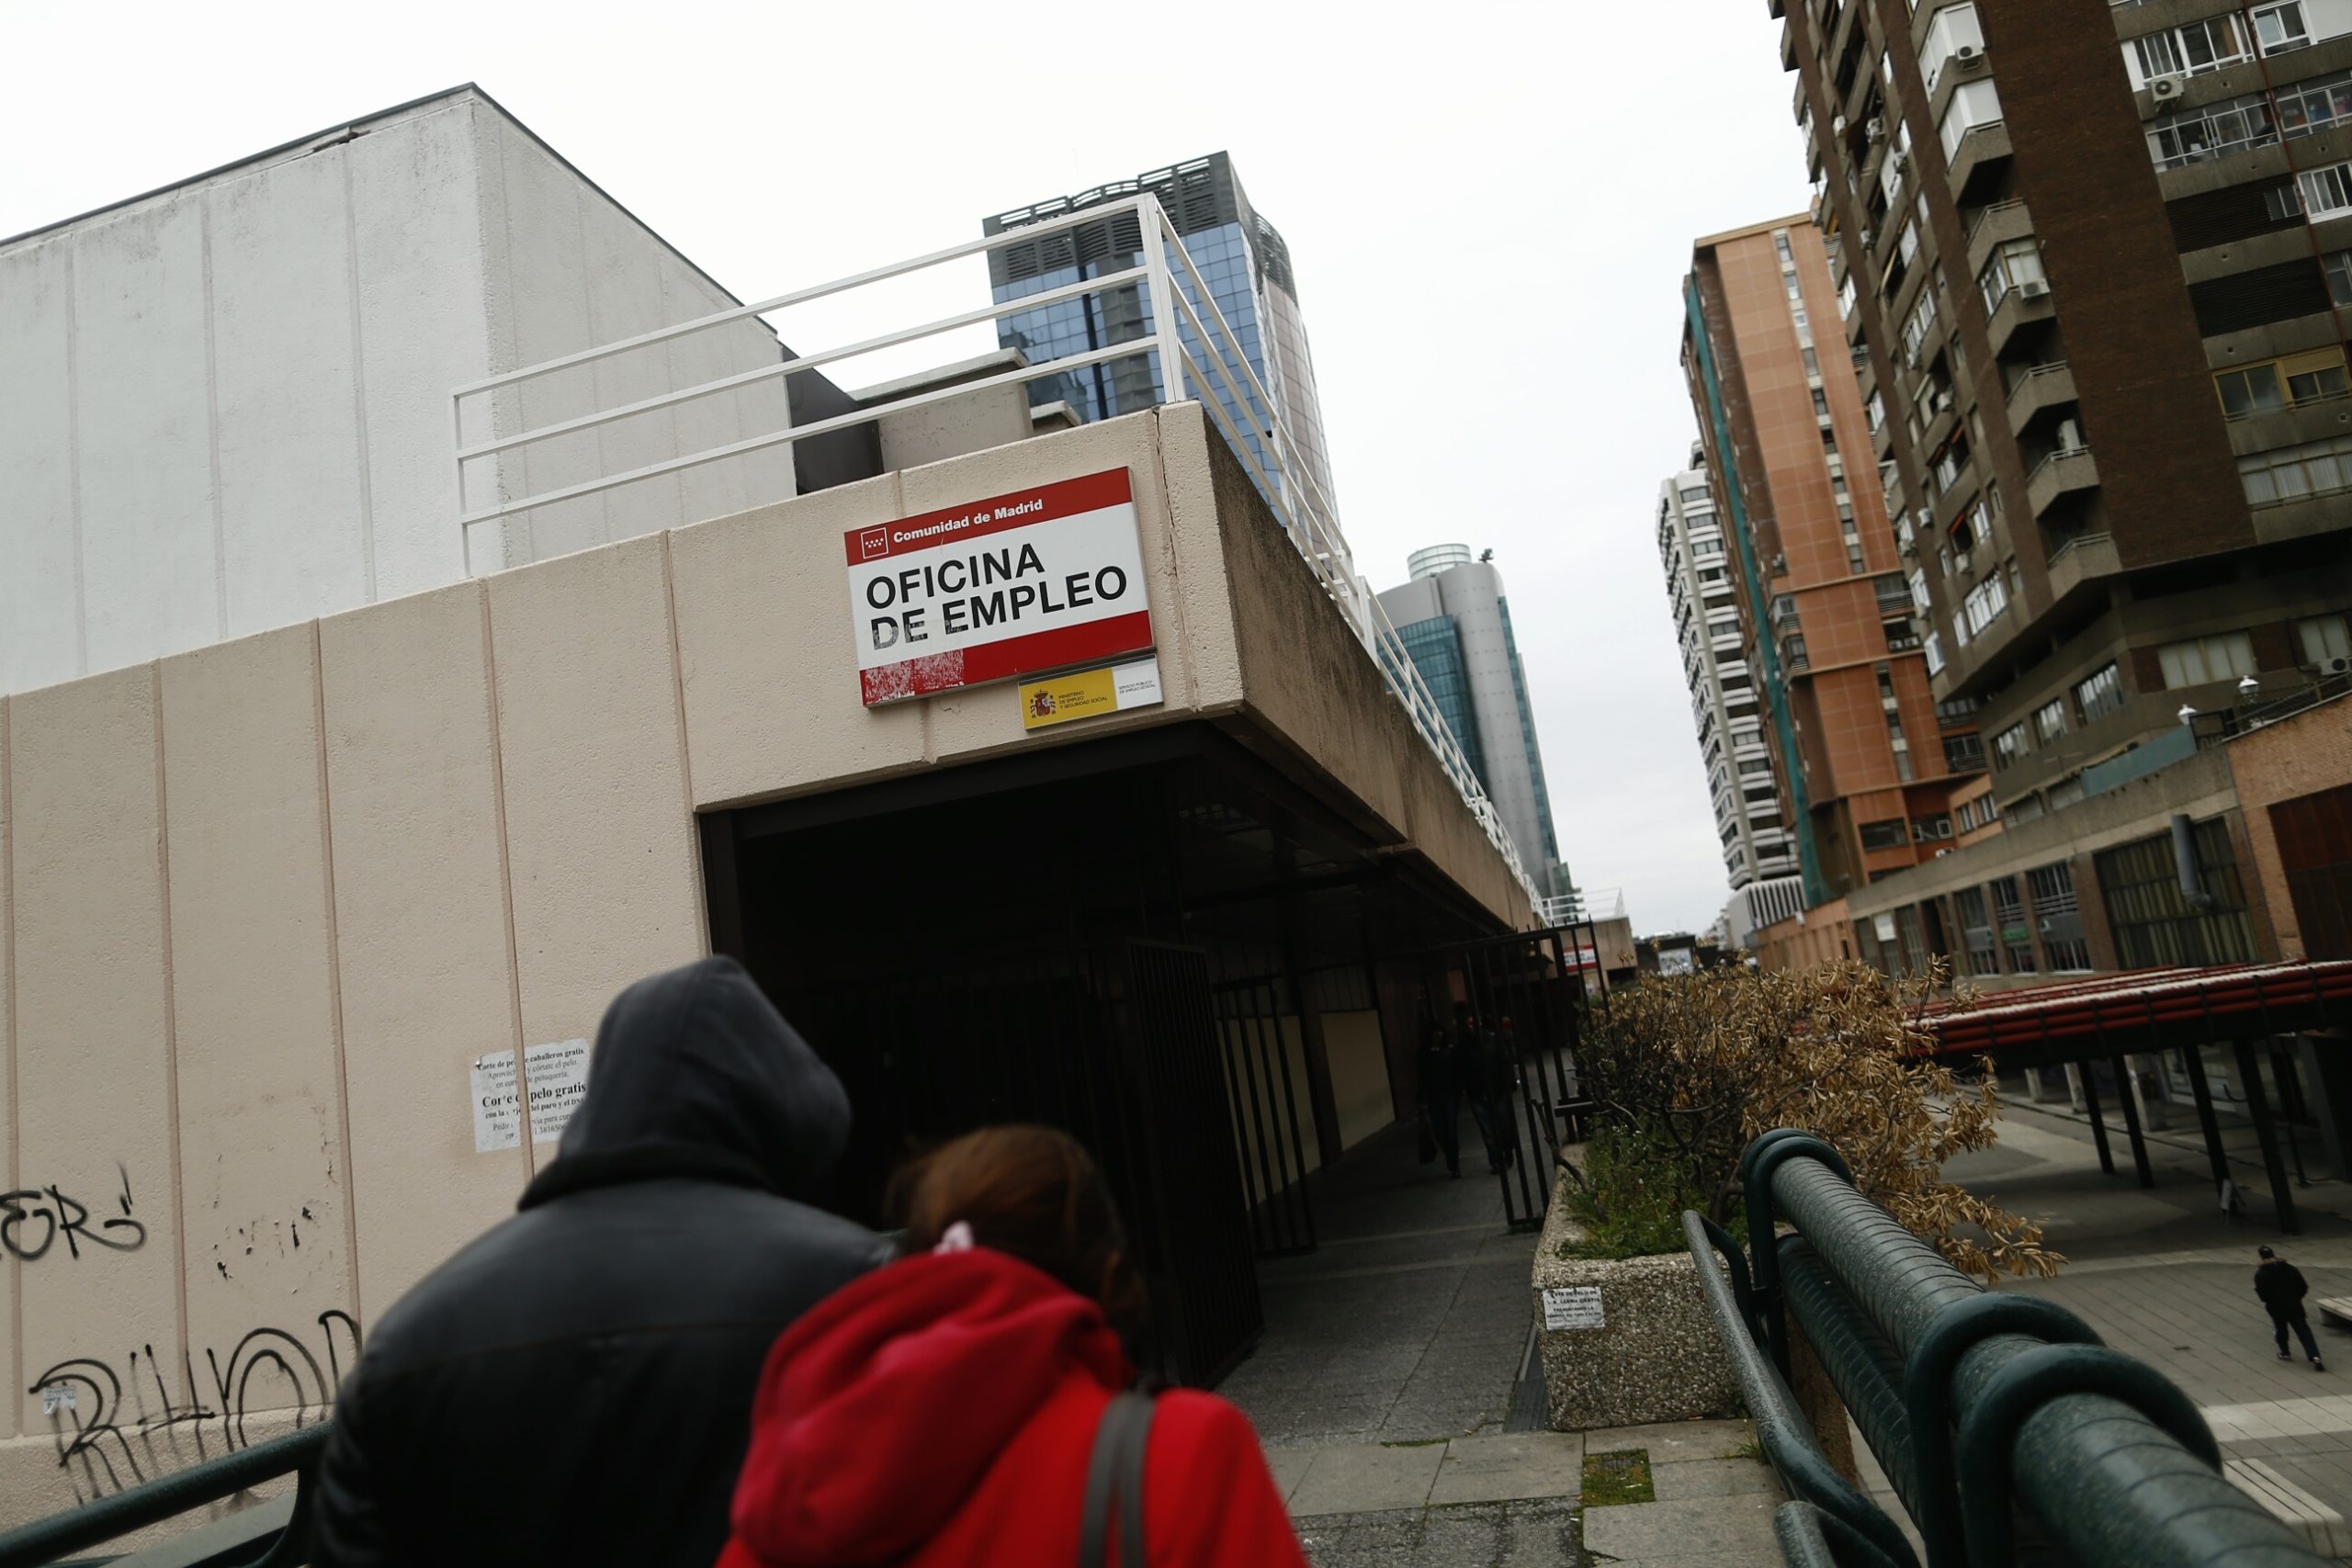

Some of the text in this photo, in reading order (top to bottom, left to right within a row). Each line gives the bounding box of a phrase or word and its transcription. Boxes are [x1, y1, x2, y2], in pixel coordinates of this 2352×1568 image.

[893, 499, 1044, 543] Comunidad de Madrid
[865, 543, 1046, 609] OFICINA
[870, 565, 1127, 650] DE EMPLEO
[1058, 690, 1084, 698] MINISTERIO
[1064, 699, 1091, 708] SEGURIDAD
[530, 1052, 564, 1063] caballeros
[530, 1088, 552, 1103] pelo
[555, 1081, 586, 1099] gratis
[541, 1102, 557, 1111] paro
